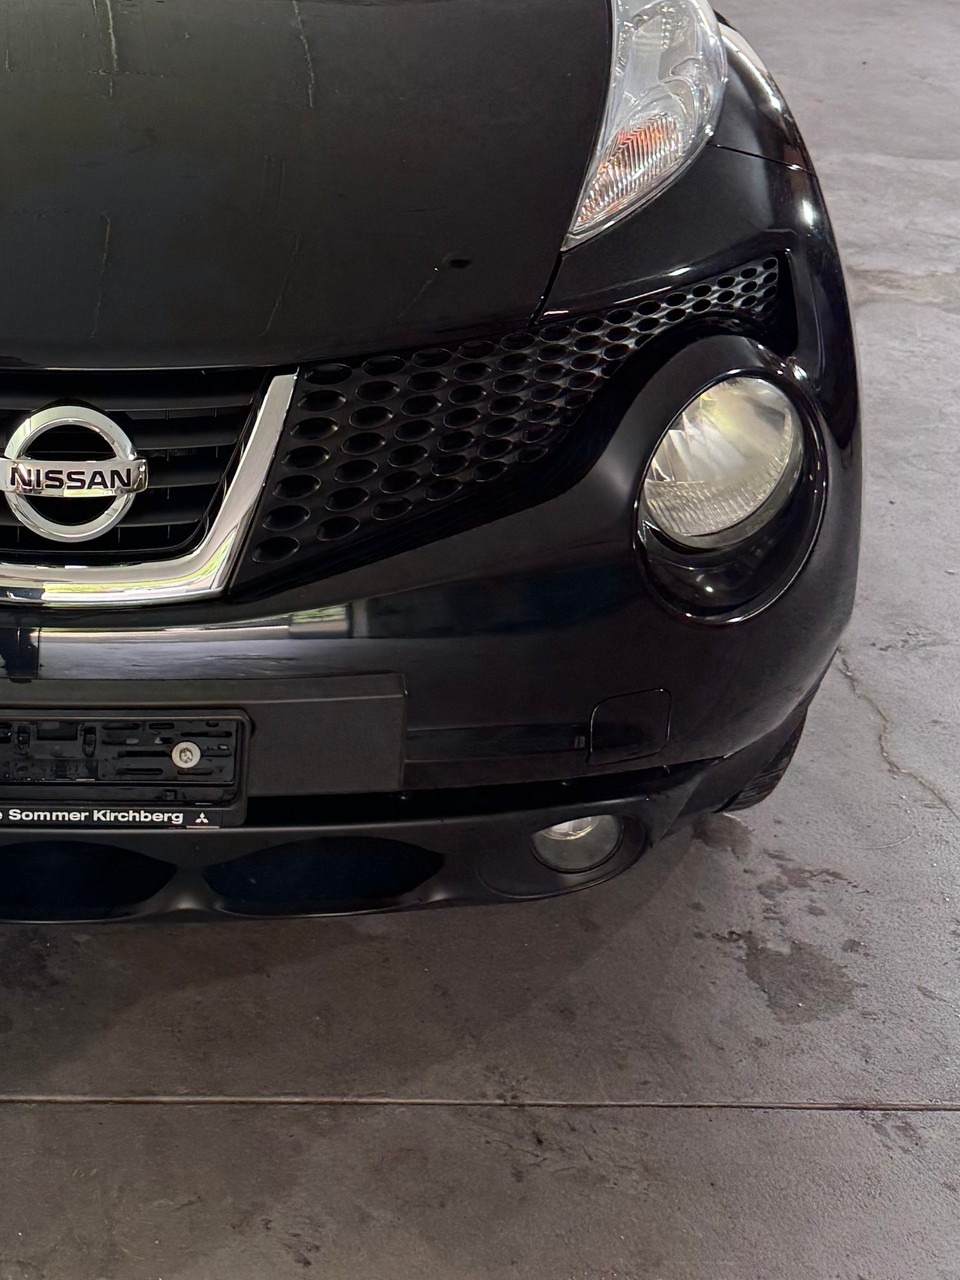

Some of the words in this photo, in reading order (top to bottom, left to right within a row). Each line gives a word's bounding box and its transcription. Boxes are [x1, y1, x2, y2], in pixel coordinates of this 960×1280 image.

[10, 464, 131, 490] NISSAN
[8, 808, 89, 822] Sommer
[93, 809, 184, 825] Kirchberg
